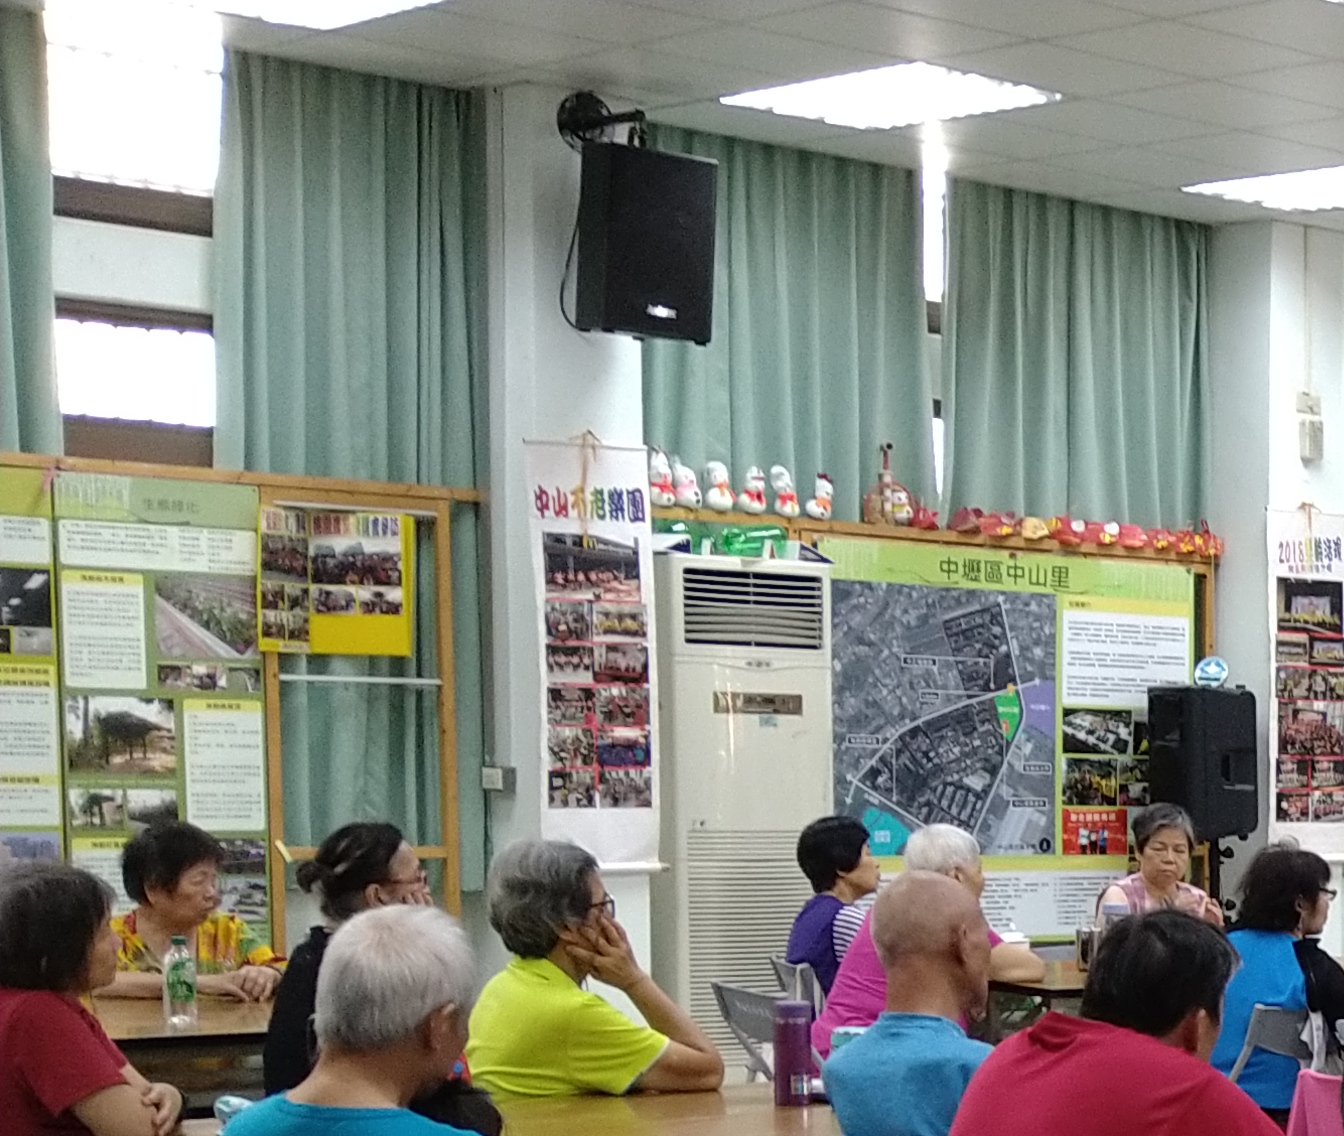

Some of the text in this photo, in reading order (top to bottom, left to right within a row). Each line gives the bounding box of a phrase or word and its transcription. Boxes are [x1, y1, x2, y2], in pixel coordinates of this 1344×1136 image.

[939, 556, 1070, 589] 中壢區中山里
